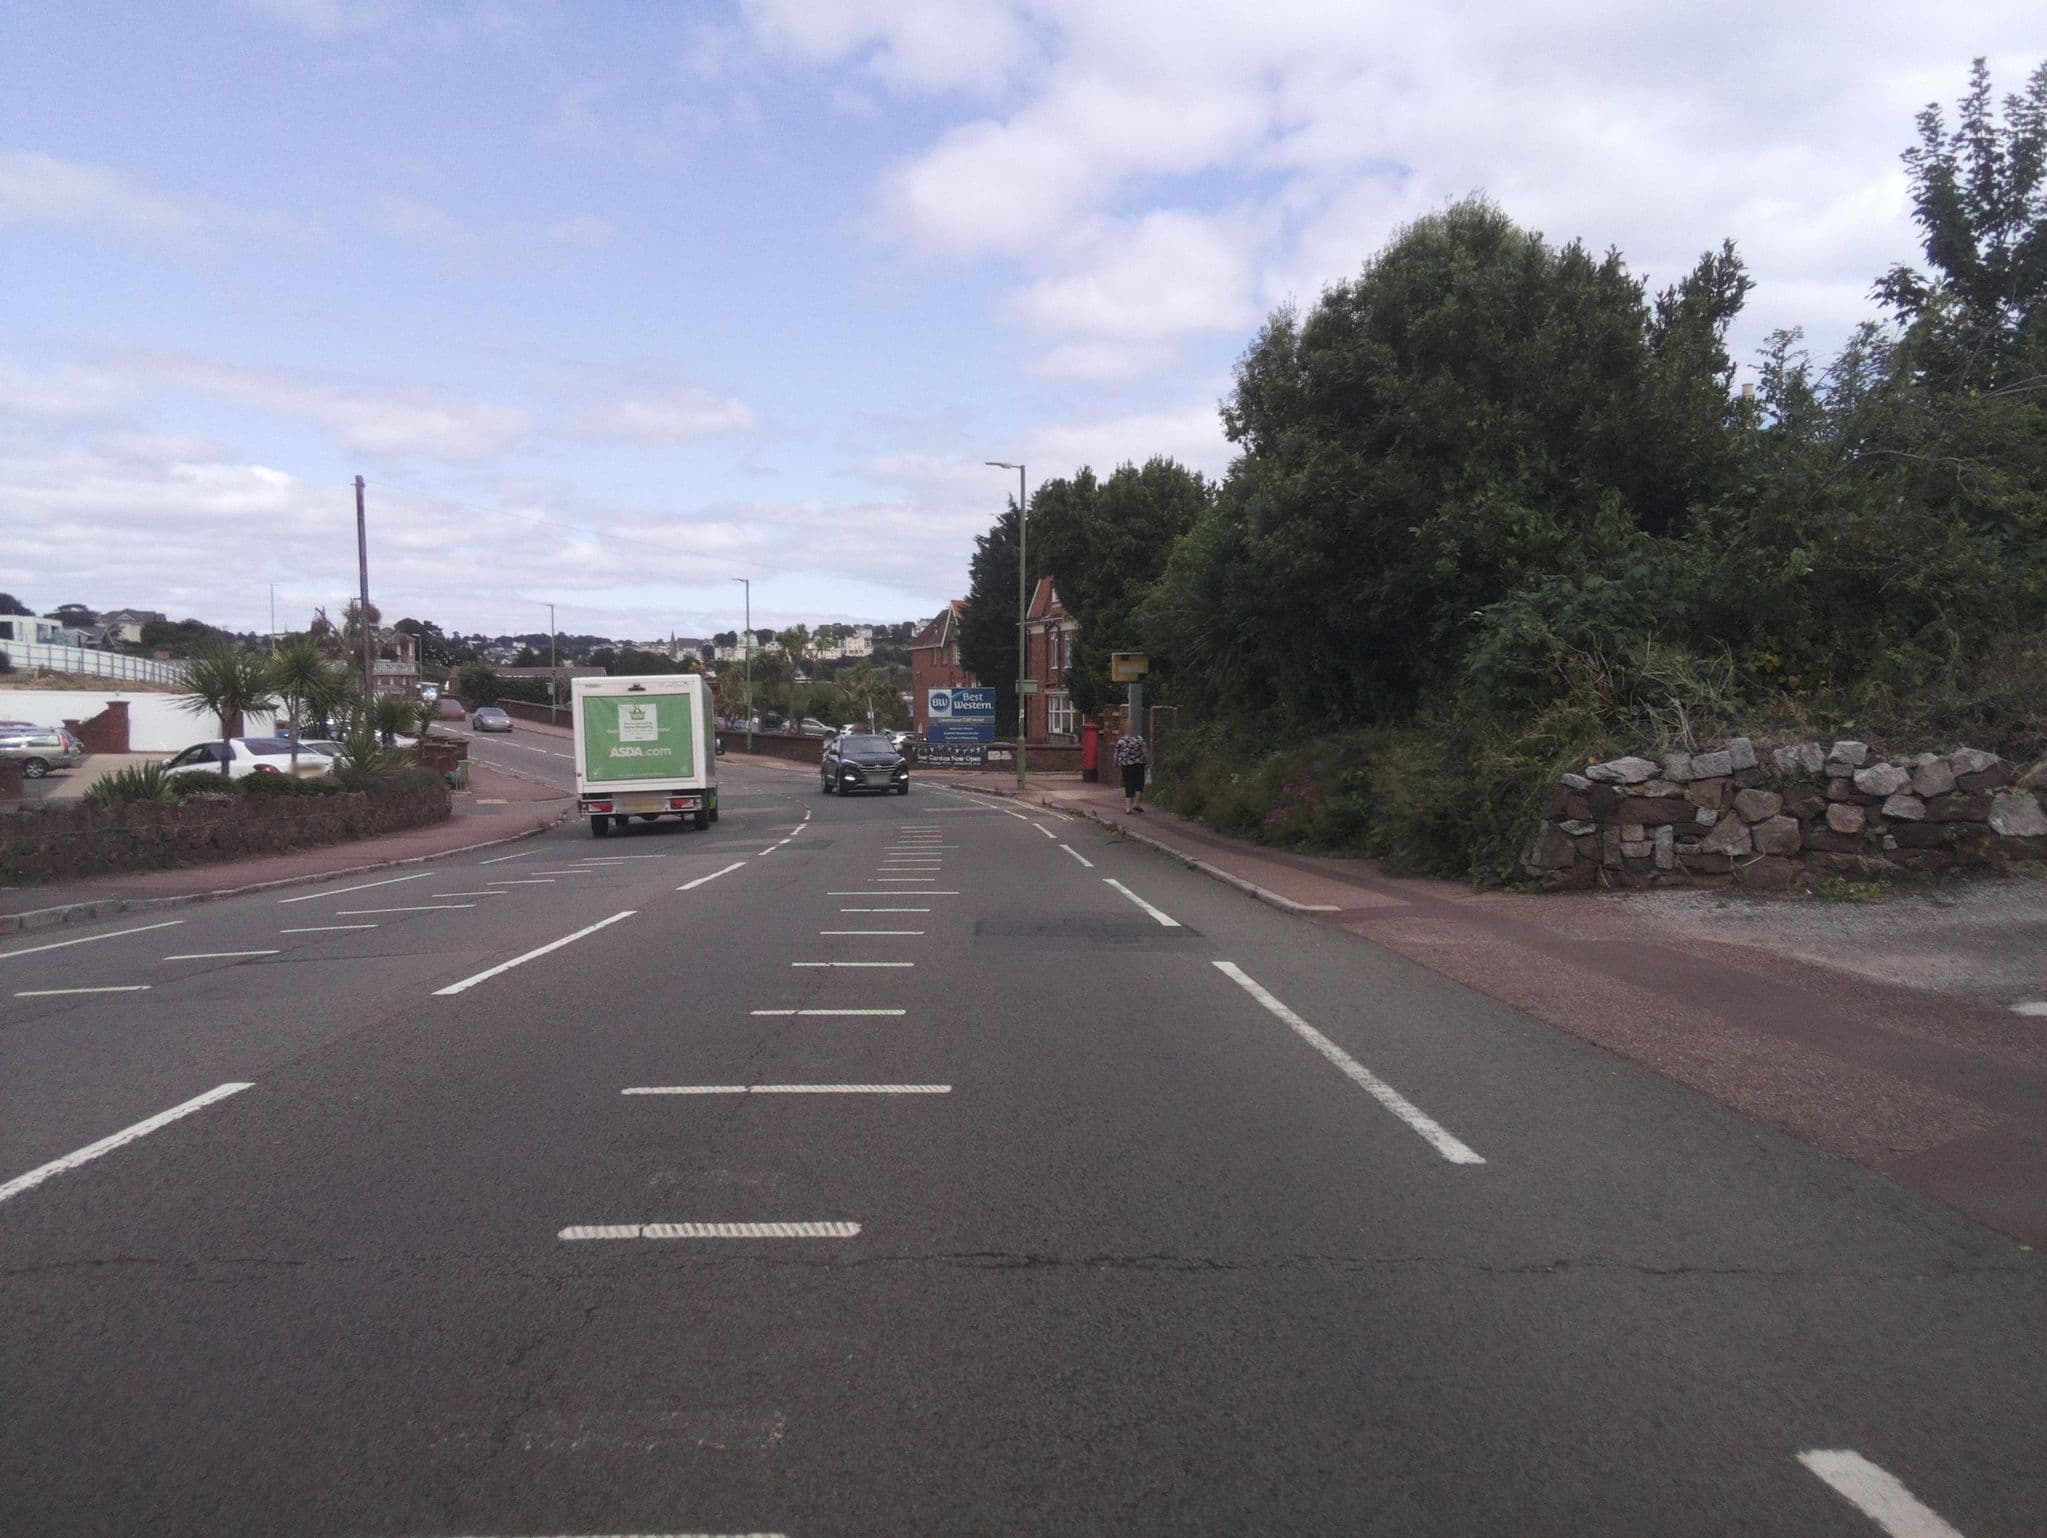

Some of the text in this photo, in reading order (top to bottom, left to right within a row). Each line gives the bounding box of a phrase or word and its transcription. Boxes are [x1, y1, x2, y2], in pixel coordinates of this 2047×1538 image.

[963, 692, 983, 701] Best
[932, 698, 948, 707] BW
[954, 701, 992, 710] Western
